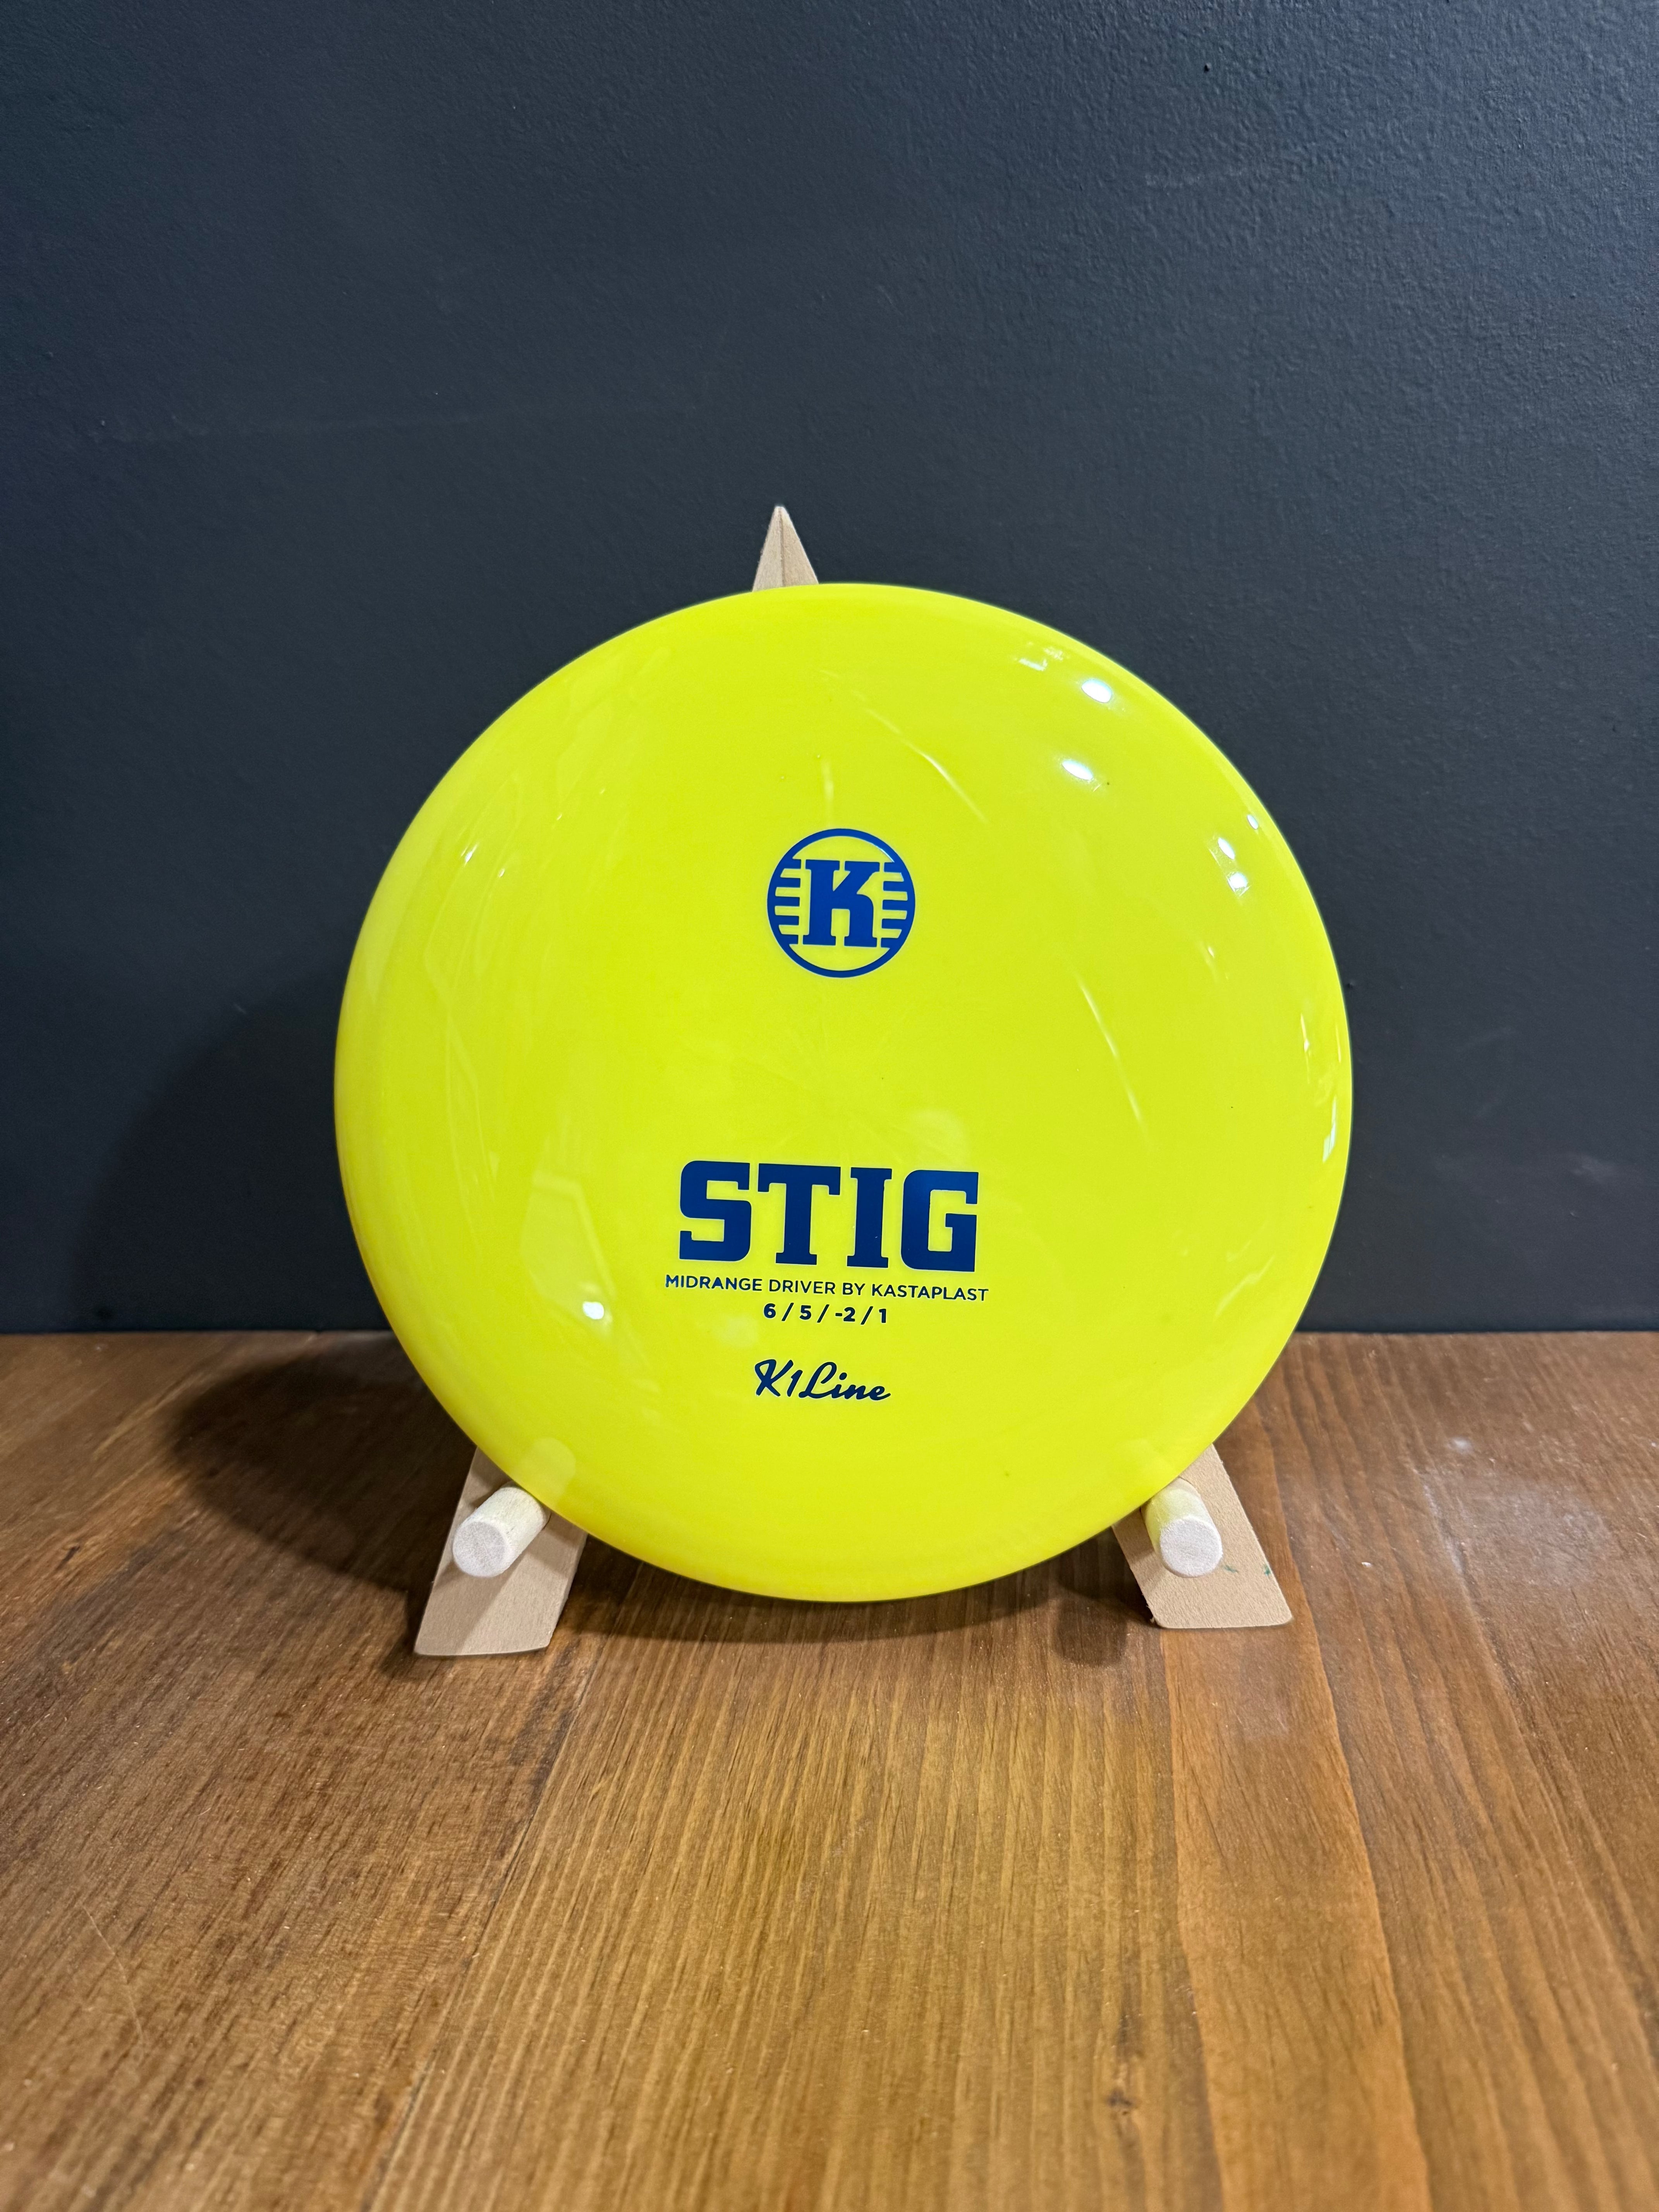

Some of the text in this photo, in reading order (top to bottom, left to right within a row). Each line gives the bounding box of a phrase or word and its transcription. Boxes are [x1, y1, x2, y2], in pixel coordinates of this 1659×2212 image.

[802, 859, 880, 948] K
[679, 1160, 979, 1272] STIG
[665, 1274, 989, 1301] MIDRANGE DRIVER BY KASTAPLAST
